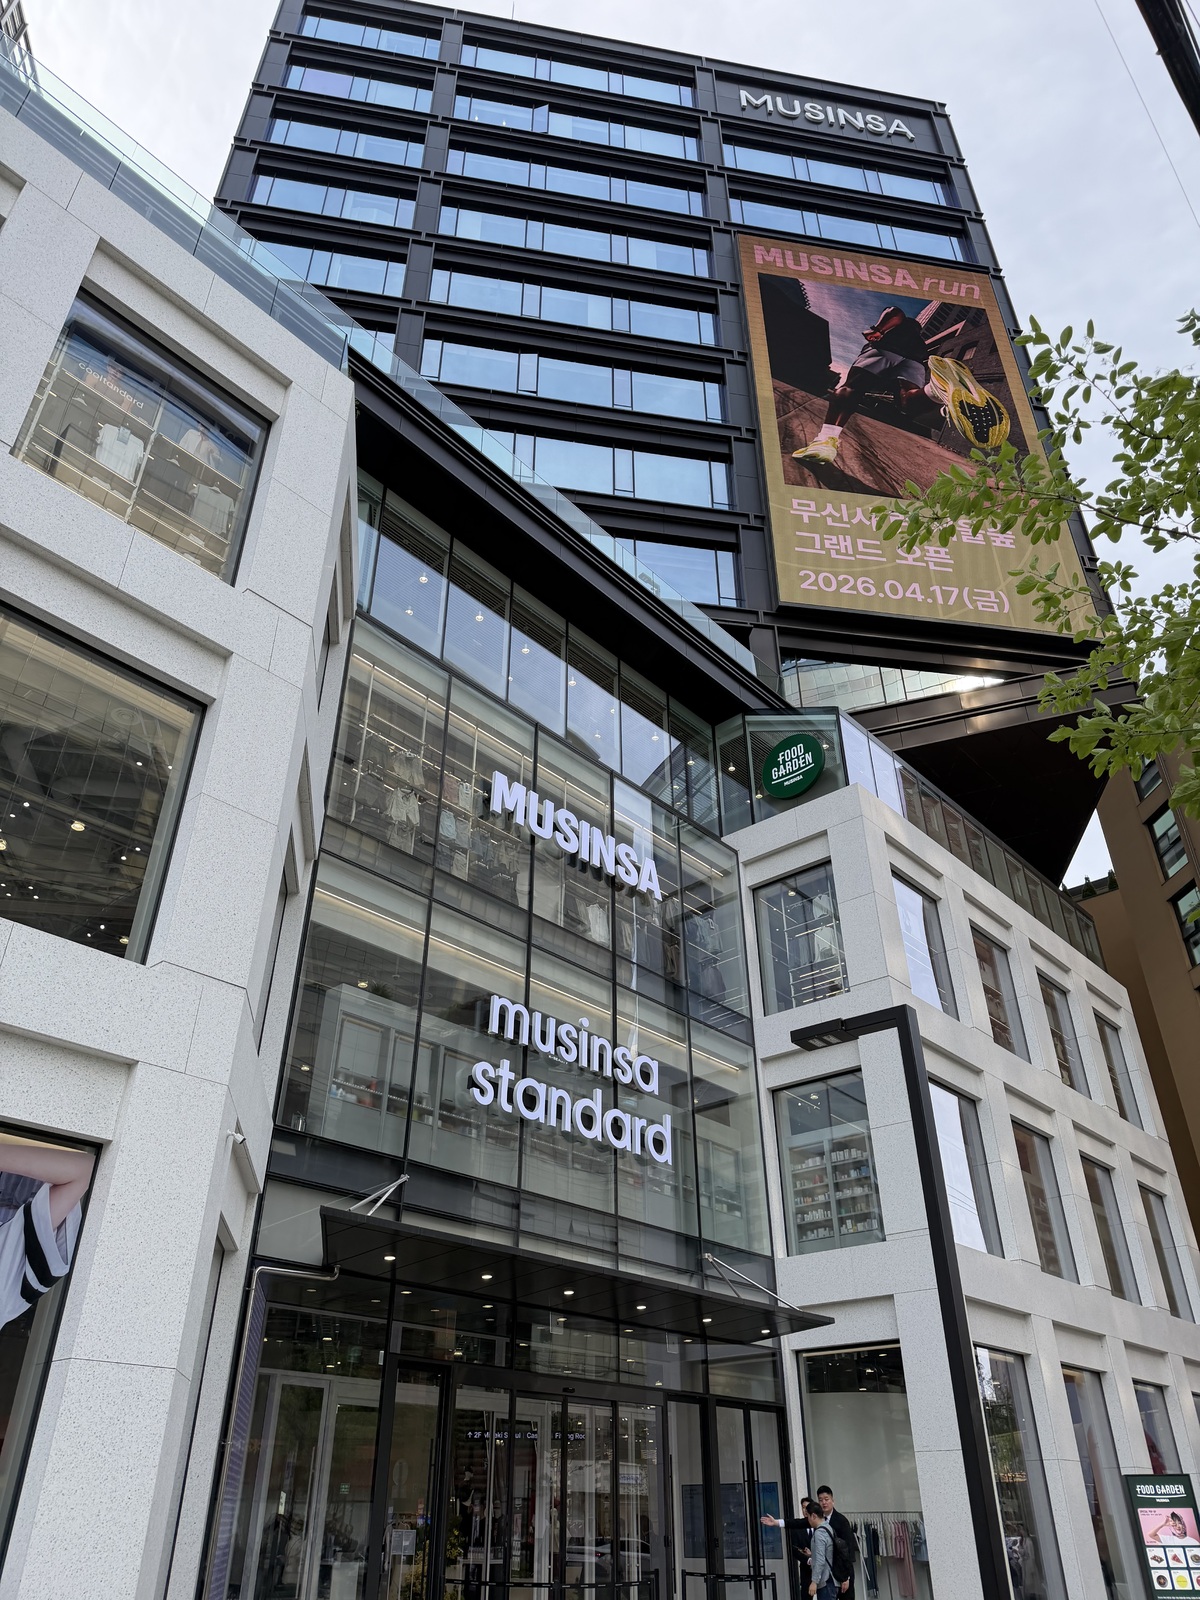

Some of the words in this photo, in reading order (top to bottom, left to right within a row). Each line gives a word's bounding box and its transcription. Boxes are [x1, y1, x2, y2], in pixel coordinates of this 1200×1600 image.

[740, 89, 916, 142] MUSINSA
[754, 244, 918, 290] MUSINSA
[924, 277, 980, 300] run
[78, 362, 144, 409] cooltandard
[790, 498, 878, 532] 무신사
[932, 517, 1016, 549] 울숲
[795, 531, 887, 561] 그랜드
[896, 543, 954, 573] 오픈
[798, 569, 1010, 614] 2026.04.17(금)
[771, 752, 813, 780] GARDEN
[777, 743, 805, 765] FOOD
[490, 770, 663, 901] MUSINSA
[488, 994, 659, 1096] musinsa
[469, 1058, 673, 1166] standard
[1136, 1484, 1155, 1495] FOOD
[1155, 1484, 1185, 1495] GARDEN
